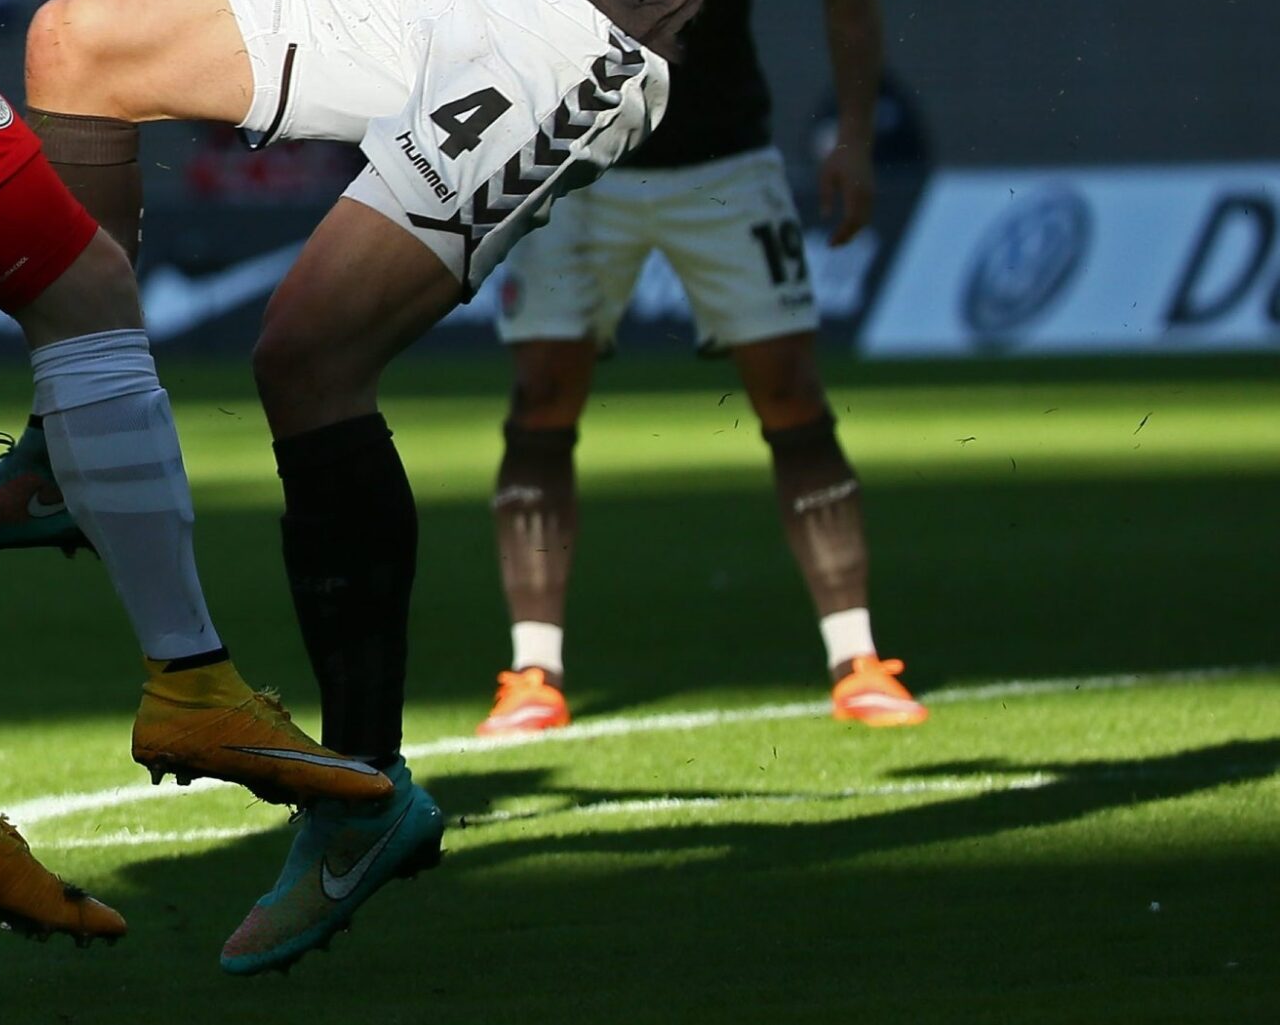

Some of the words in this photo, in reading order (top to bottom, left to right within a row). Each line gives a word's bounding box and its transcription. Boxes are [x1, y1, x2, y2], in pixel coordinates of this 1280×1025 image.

[429, 86, 513, 161] 4
[395, 130, 457, 204] hummel
[751, 219, 809, 285] 19
